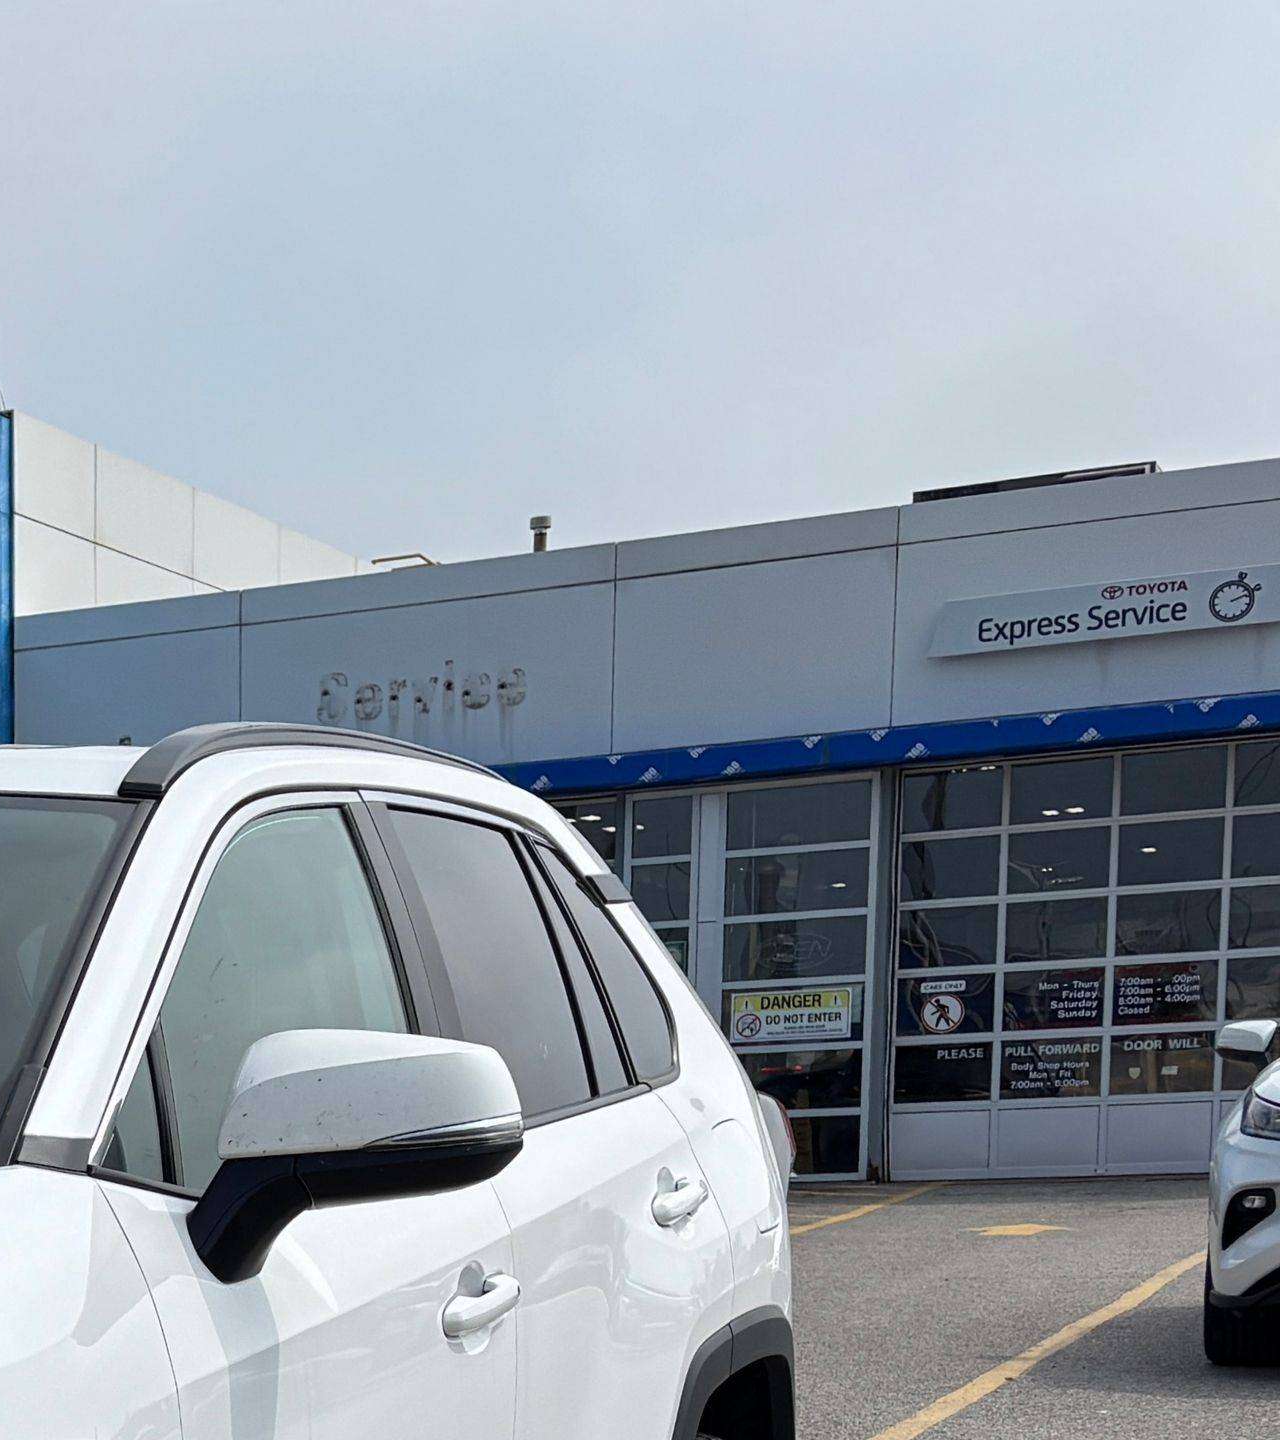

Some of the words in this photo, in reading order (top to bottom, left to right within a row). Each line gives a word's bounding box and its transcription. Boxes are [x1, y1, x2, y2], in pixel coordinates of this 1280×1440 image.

[1126, 580, 1188, 597] TOYOTA
[977, 612, 1080, 645] Express
[1086, 599, 1187, 632] Service
[1038, 982, 1059, 991] Mon
[1062, 990, 1098, 999] Friday
[760, 994, 822, 1010] DANGER
[1050, 999, 1098, 1009] Saturday
[1057, 1009, 1097, 1018] Sunday
[1118, 1006, 1150, 1015] Closed
[765, 1015, 780, 1025] DO
[783, 1013, 805, 1024] NOT
[807, 1012, 842, 1023] ENTER
[936, 1048, 984, 1060] PLEASE
[1005, 1045, 1034, 1057] PULL
[1039, 1043, 1099, 1055] FORWARD
[1123, 1040, 1162, 1051] DOOR
[1168, 1038, 1201, 1049] WILL
[1011, 1062, 1034, 1072] Body
